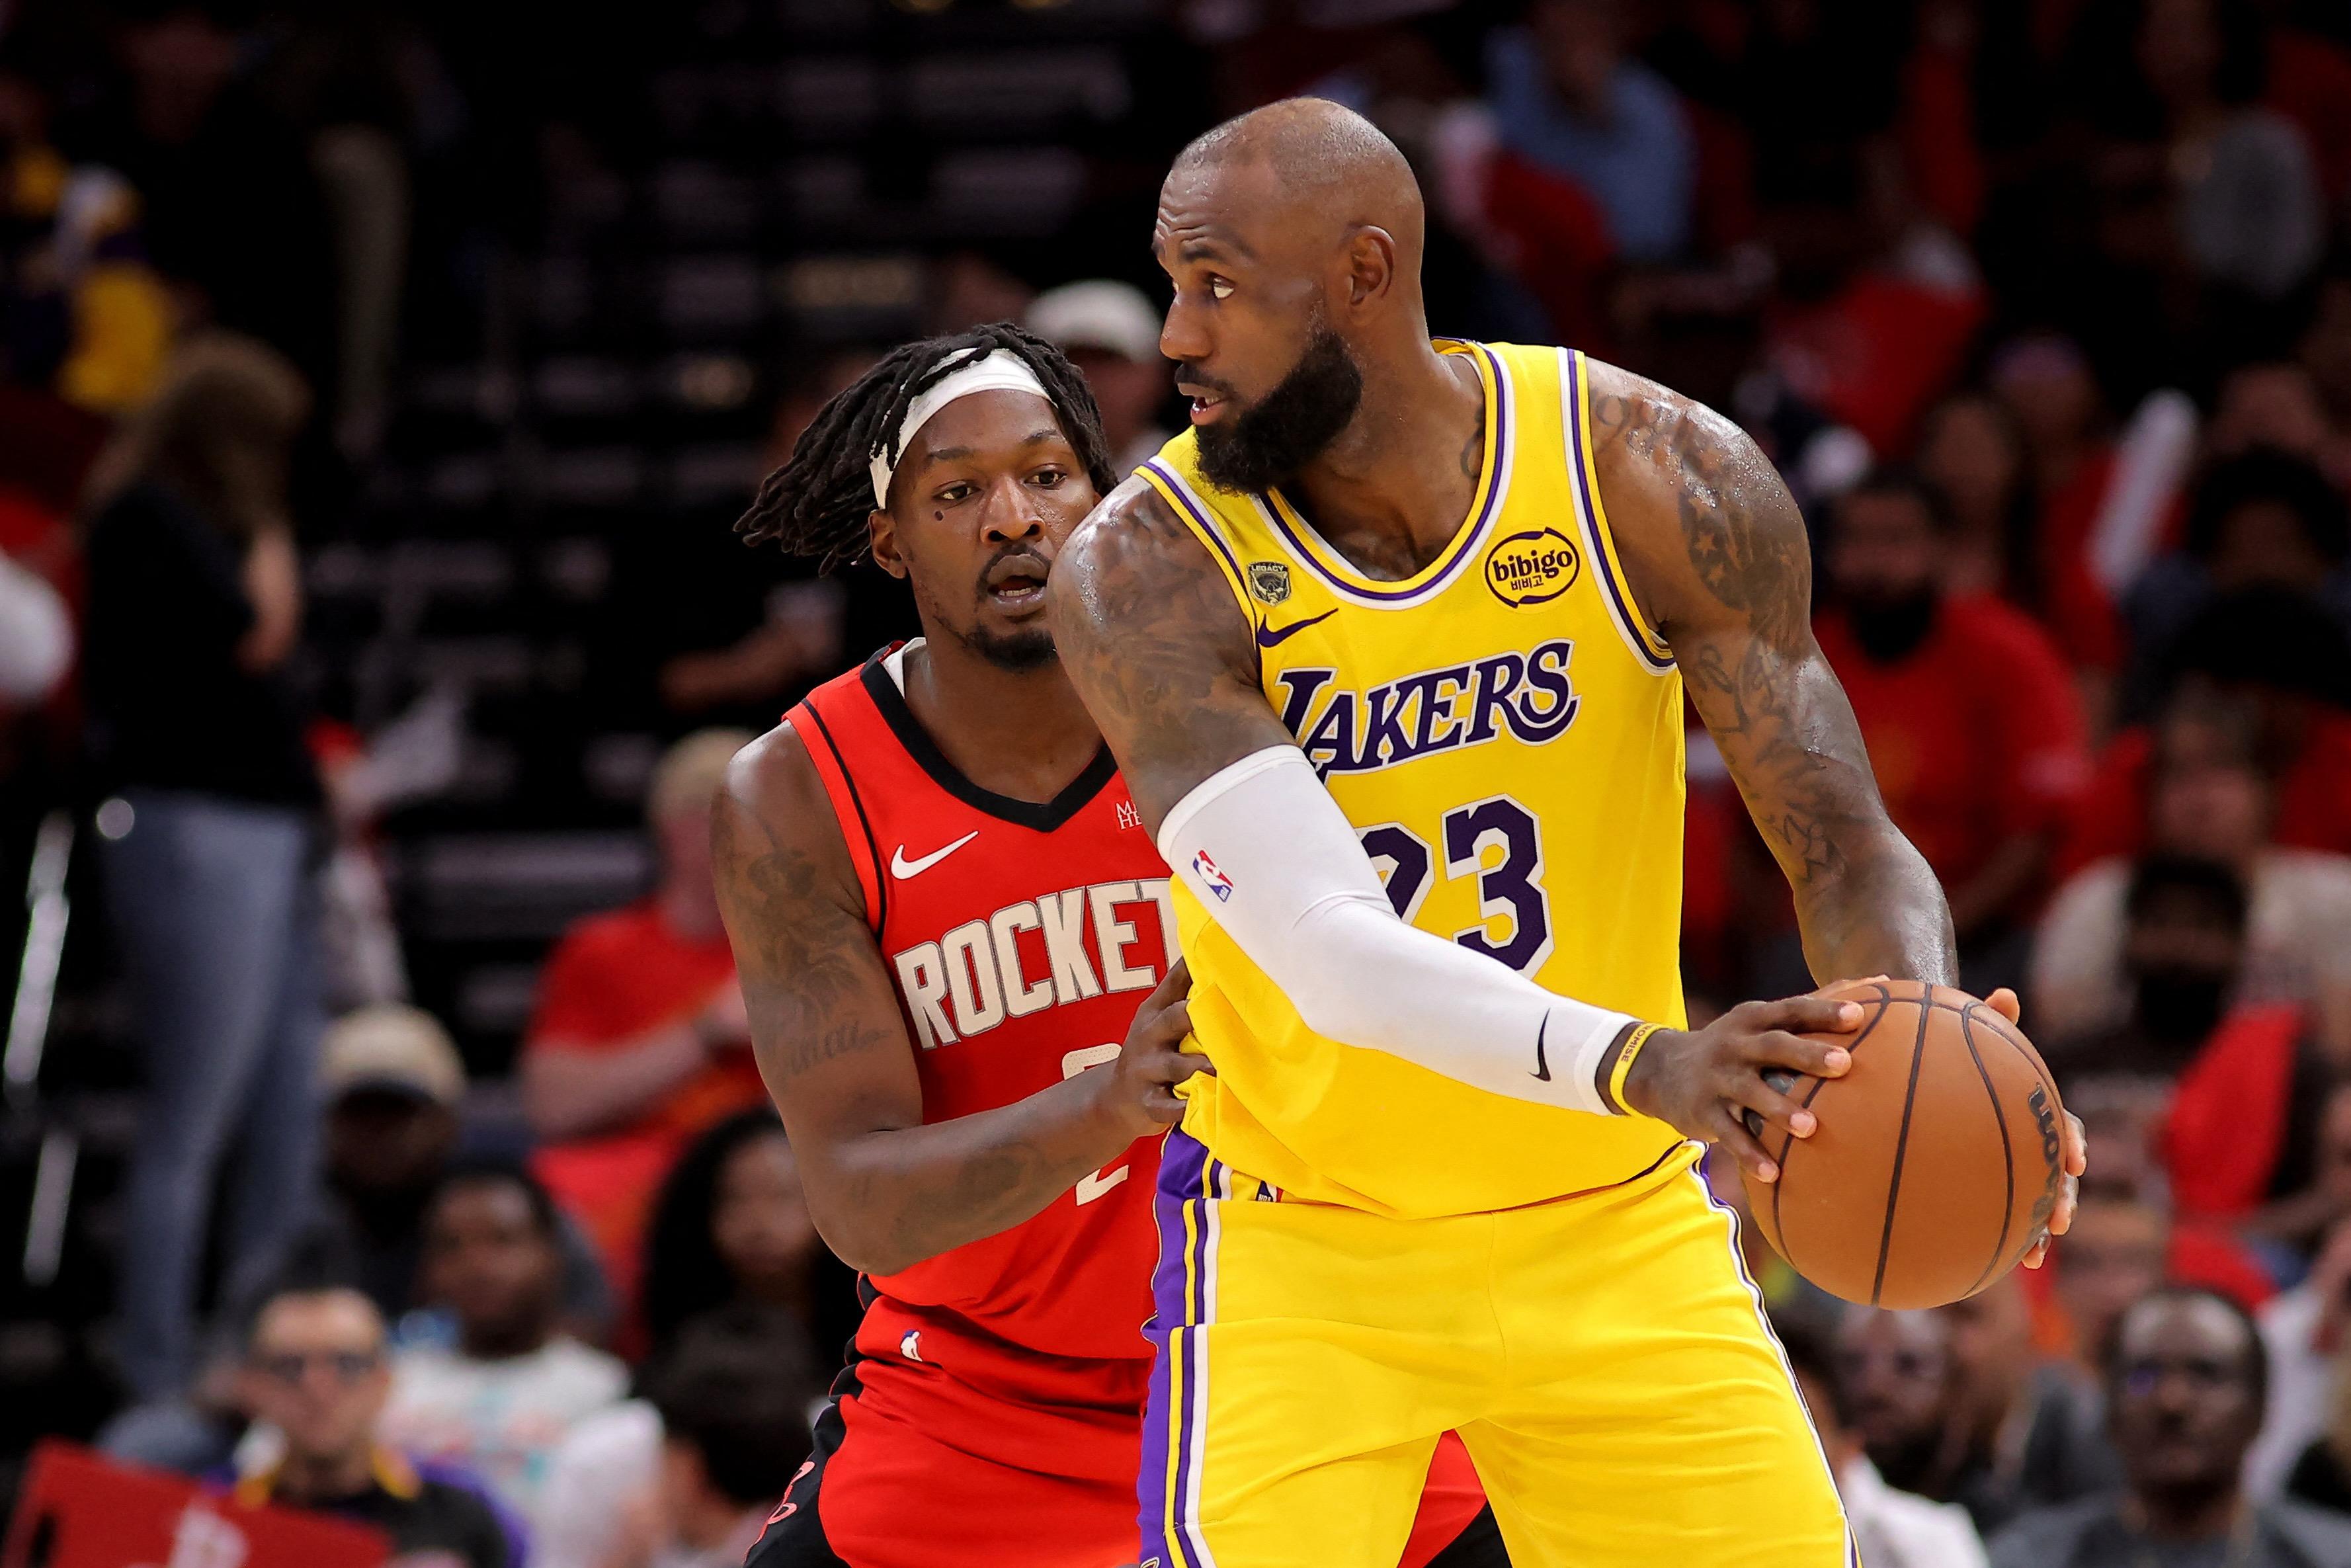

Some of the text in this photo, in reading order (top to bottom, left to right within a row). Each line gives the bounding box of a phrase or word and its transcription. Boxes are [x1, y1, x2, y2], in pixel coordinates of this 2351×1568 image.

[1493, 549, 1573, 581] bibigo
[1510, 575, 1544, 591] 비비고
[1276, 638, 1581, 783] LAKERS
[1621, 1025, 1653, 1062] ROMISE
